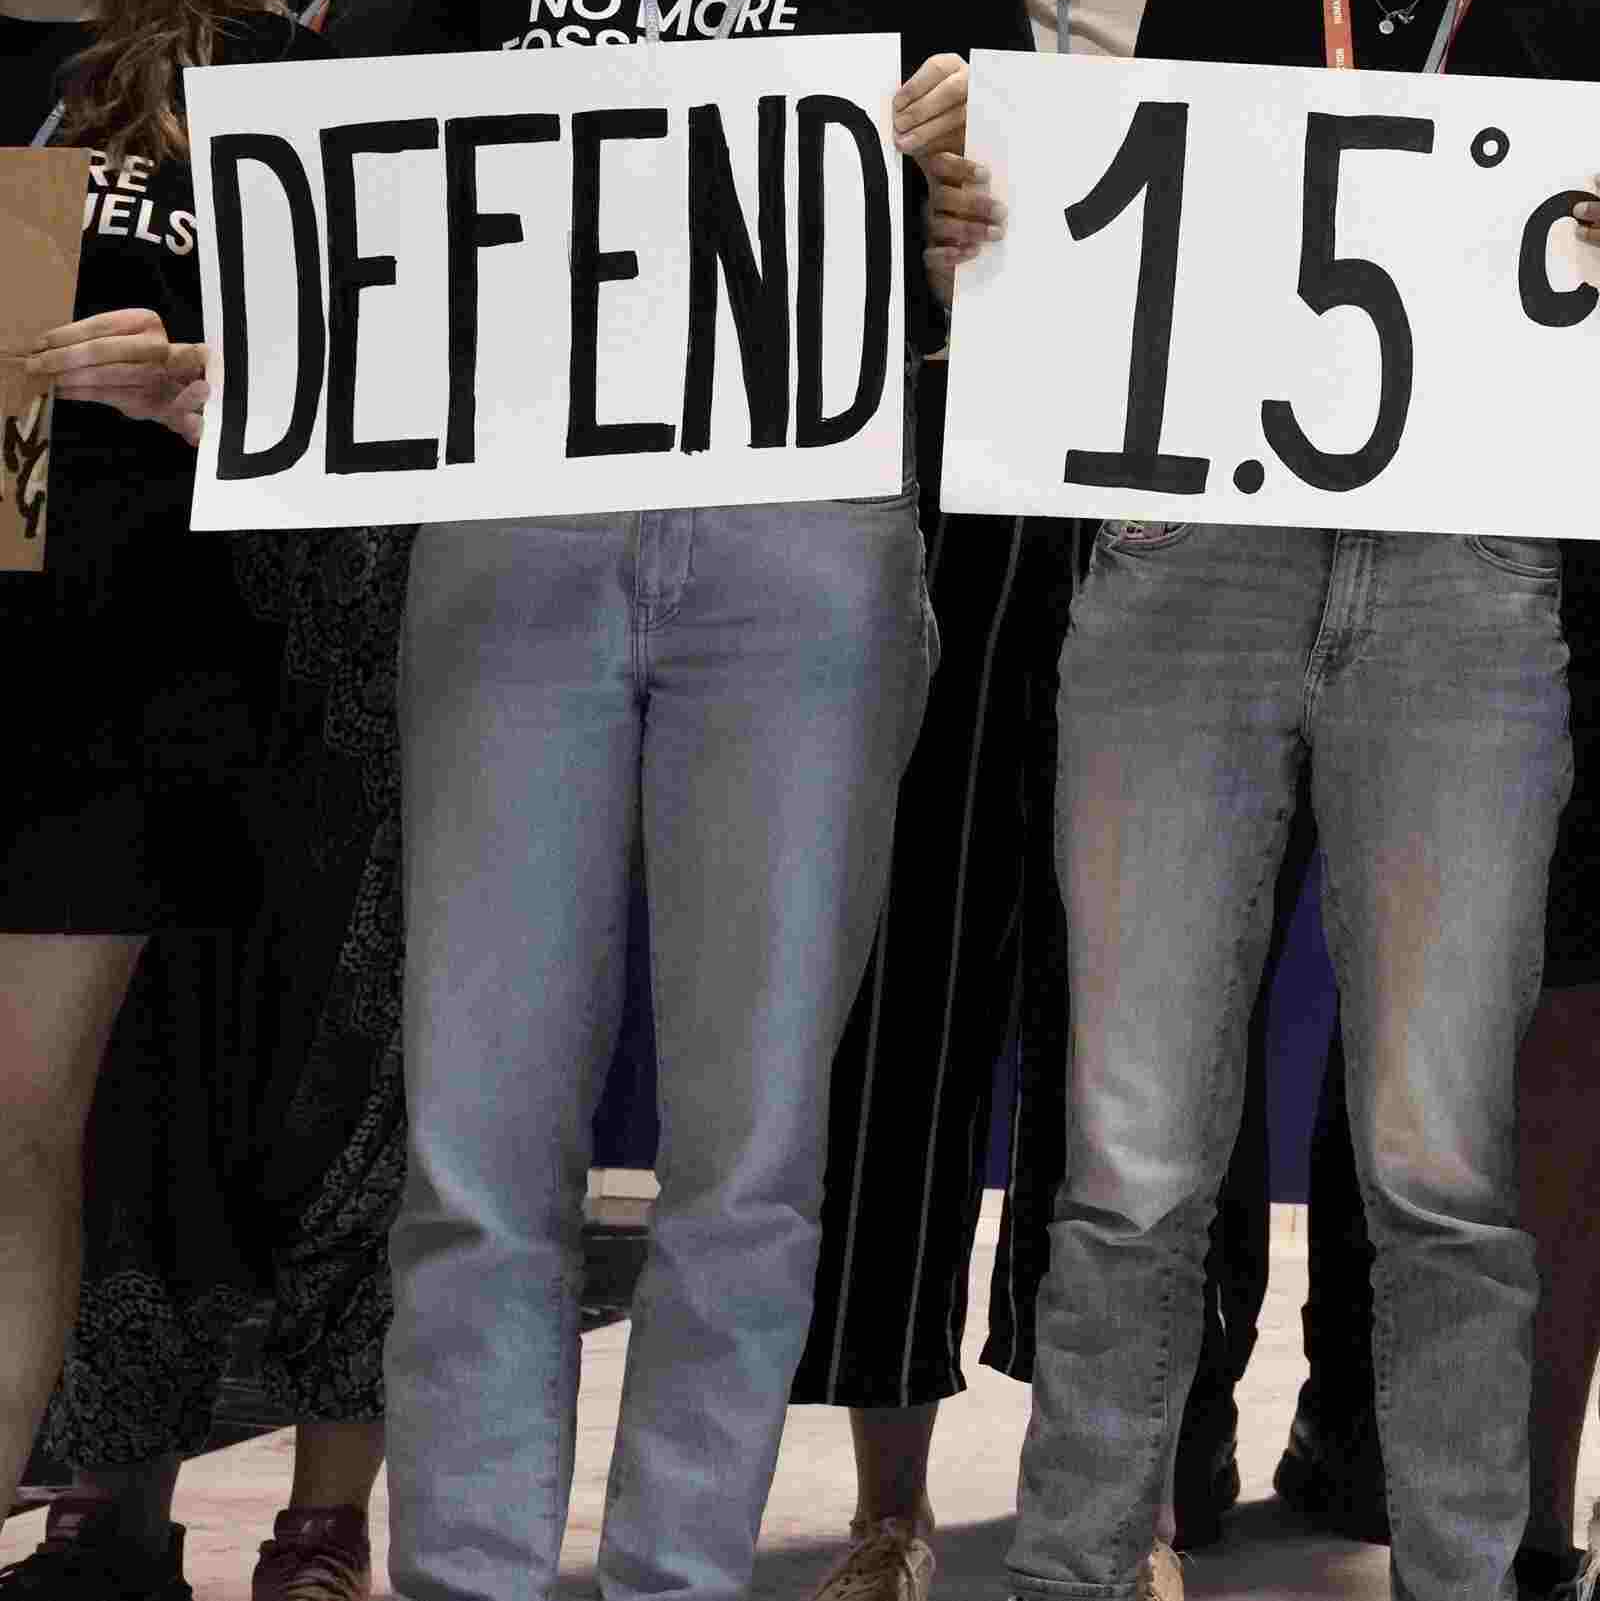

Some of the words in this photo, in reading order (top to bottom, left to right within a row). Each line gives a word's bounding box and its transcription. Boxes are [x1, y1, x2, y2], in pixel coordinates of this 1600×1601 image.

[89, 150, 156, 192] RE
[81, 192, 198, 256] ELS
[210, 94, 893, 481] DEFEND
